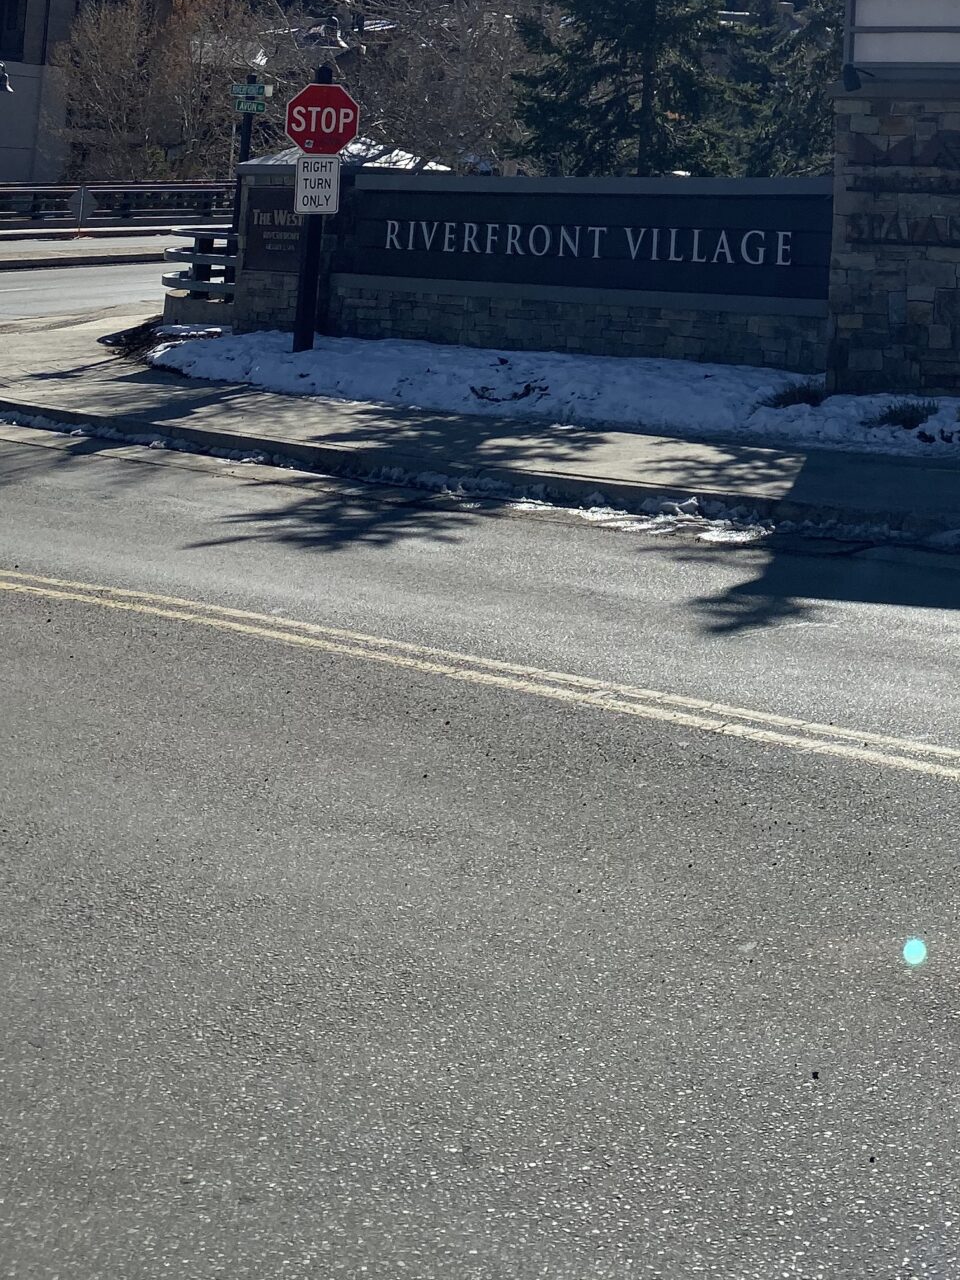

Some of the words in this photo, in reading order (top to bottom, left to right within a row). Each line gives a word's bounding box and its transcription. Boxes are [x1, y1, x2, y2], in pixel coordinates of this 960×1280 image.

[238, 101, 257, 111] AVON
[291, 106, 354, 133] STOP
[302, 161, 334, 173] RIGHT
[303, 178, 332, 189] TURN
[302, 195, 332, 207] ONLY
[384, 219, 608, 258] RIVERFRONT
[624, 227, 793, 266] VILLAGE
